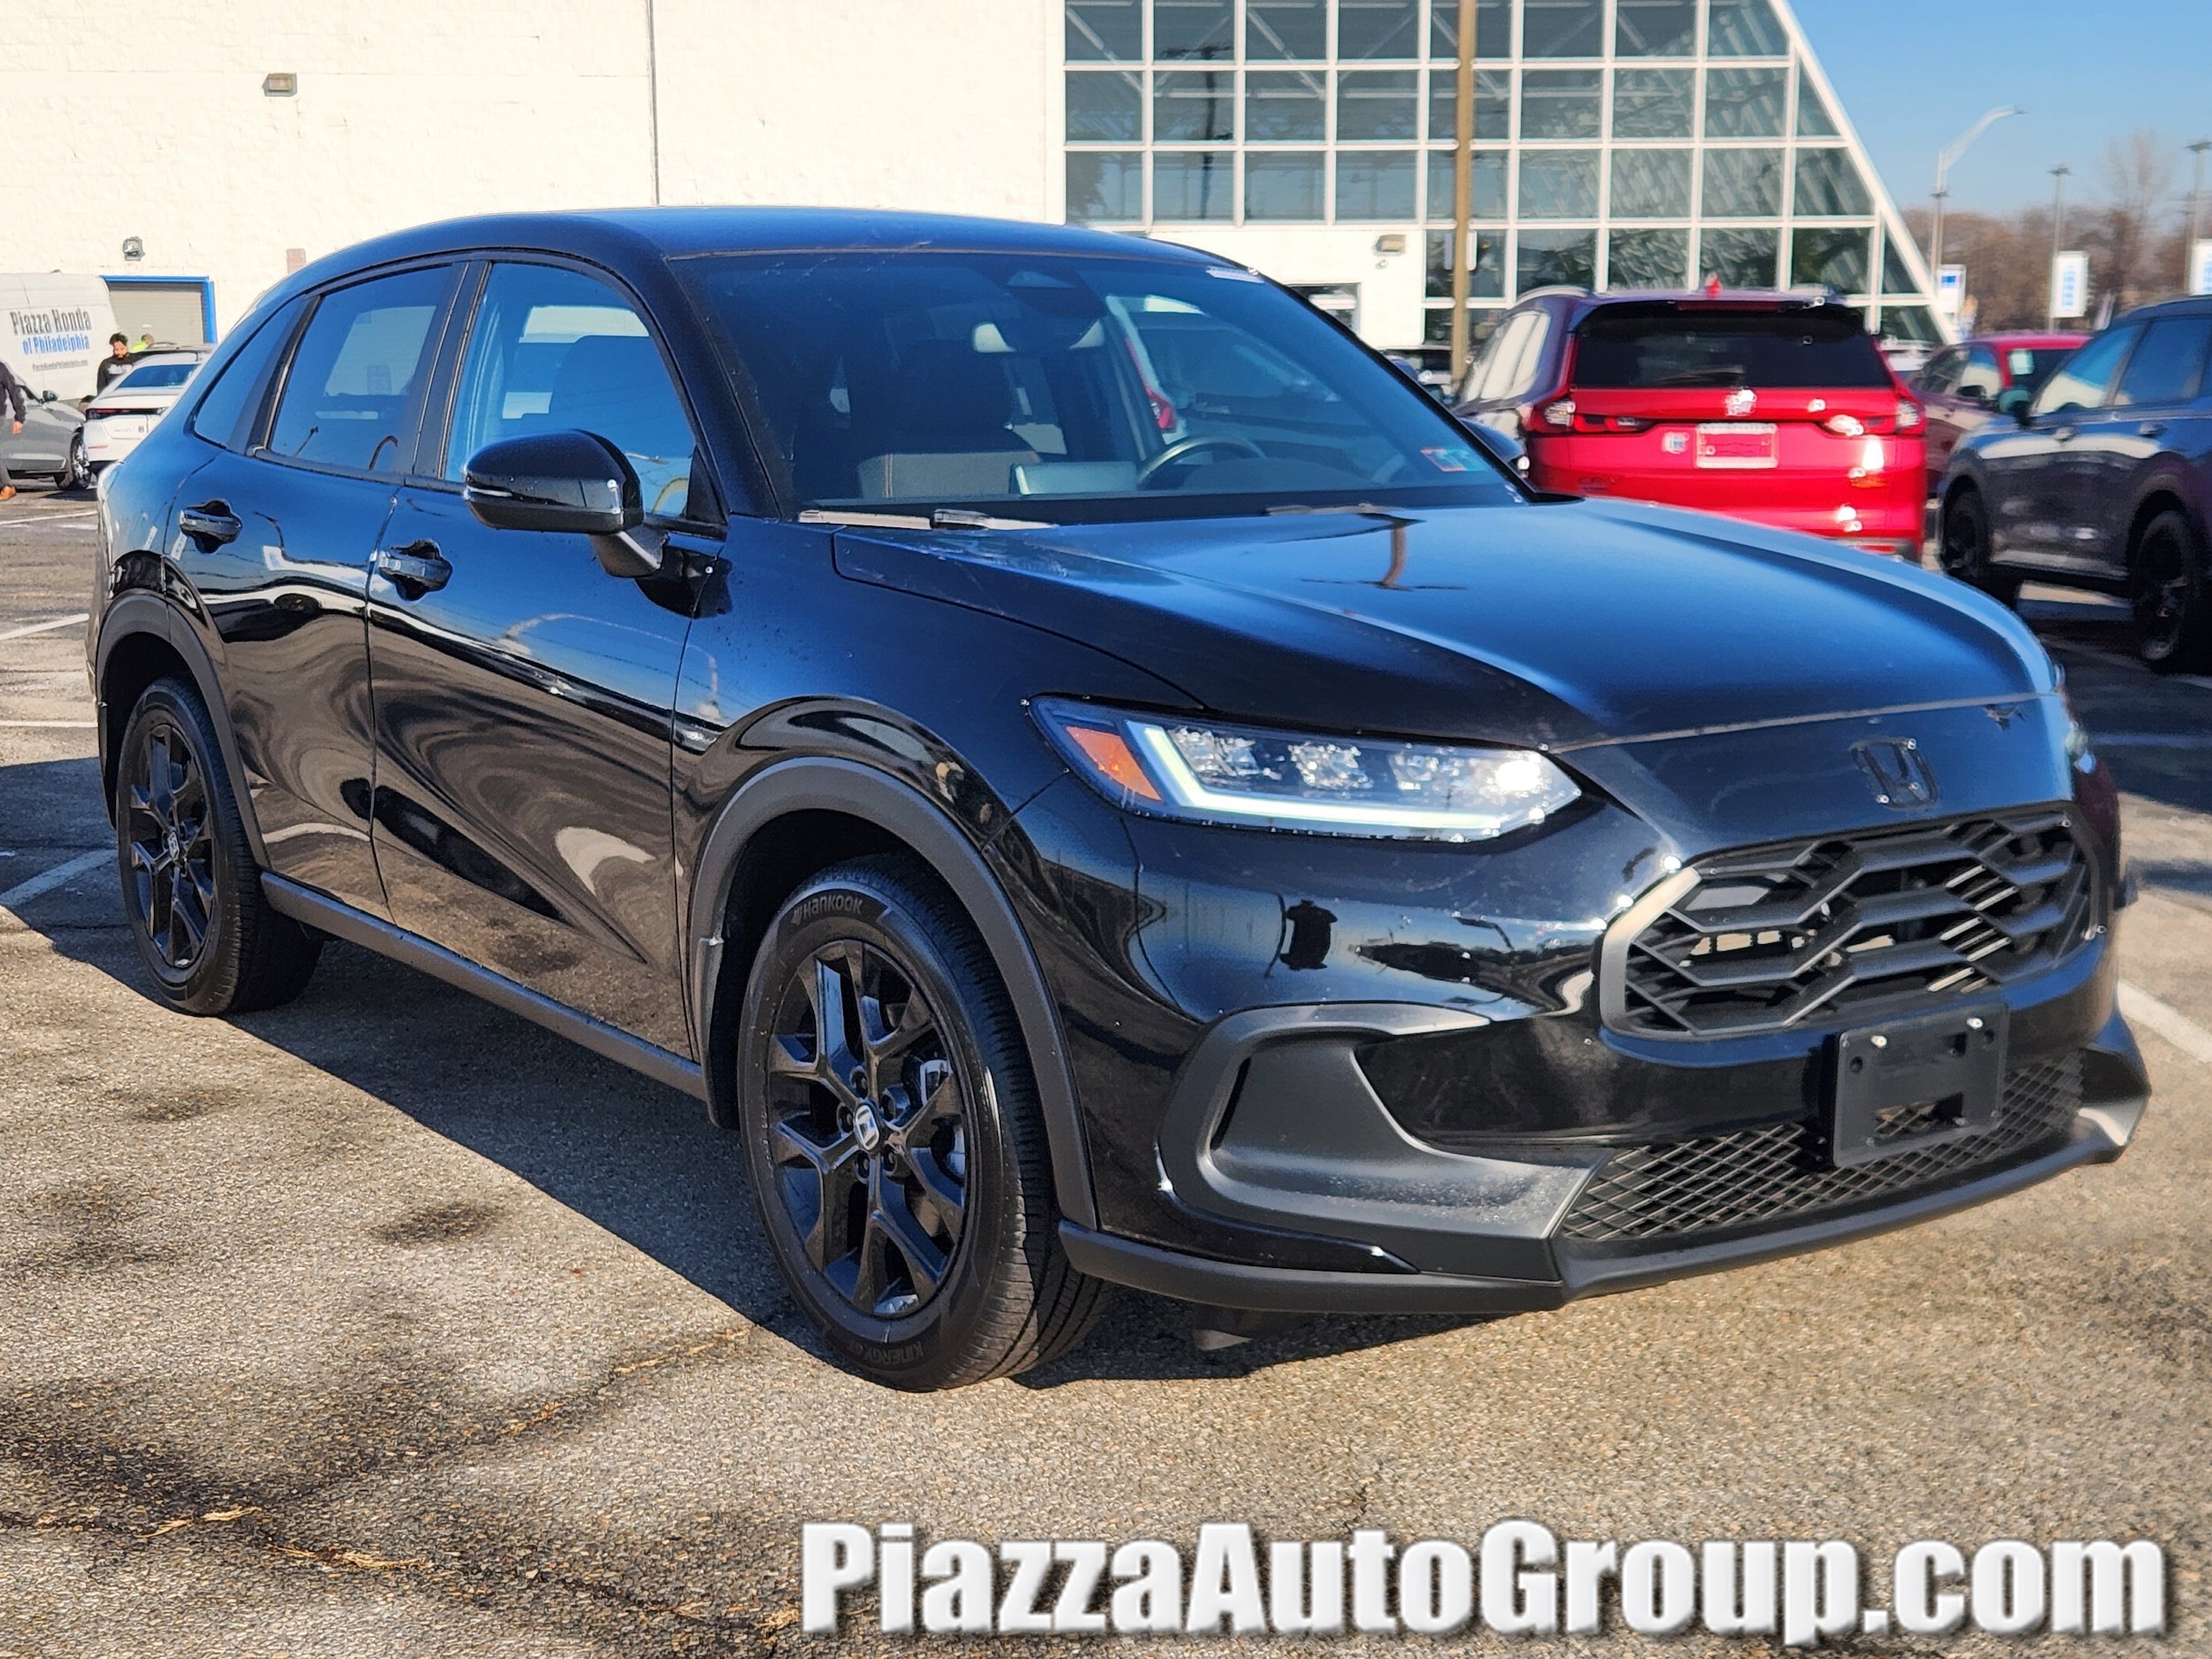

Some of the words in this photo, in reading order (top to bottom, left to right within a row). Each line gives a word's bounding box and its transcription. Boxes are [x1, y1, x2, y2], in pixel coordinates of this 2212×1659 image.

[10, 311, 52, 335] Piazza
[51, 307, 91, 332] Honda
[22, 337, 33, 355] of
